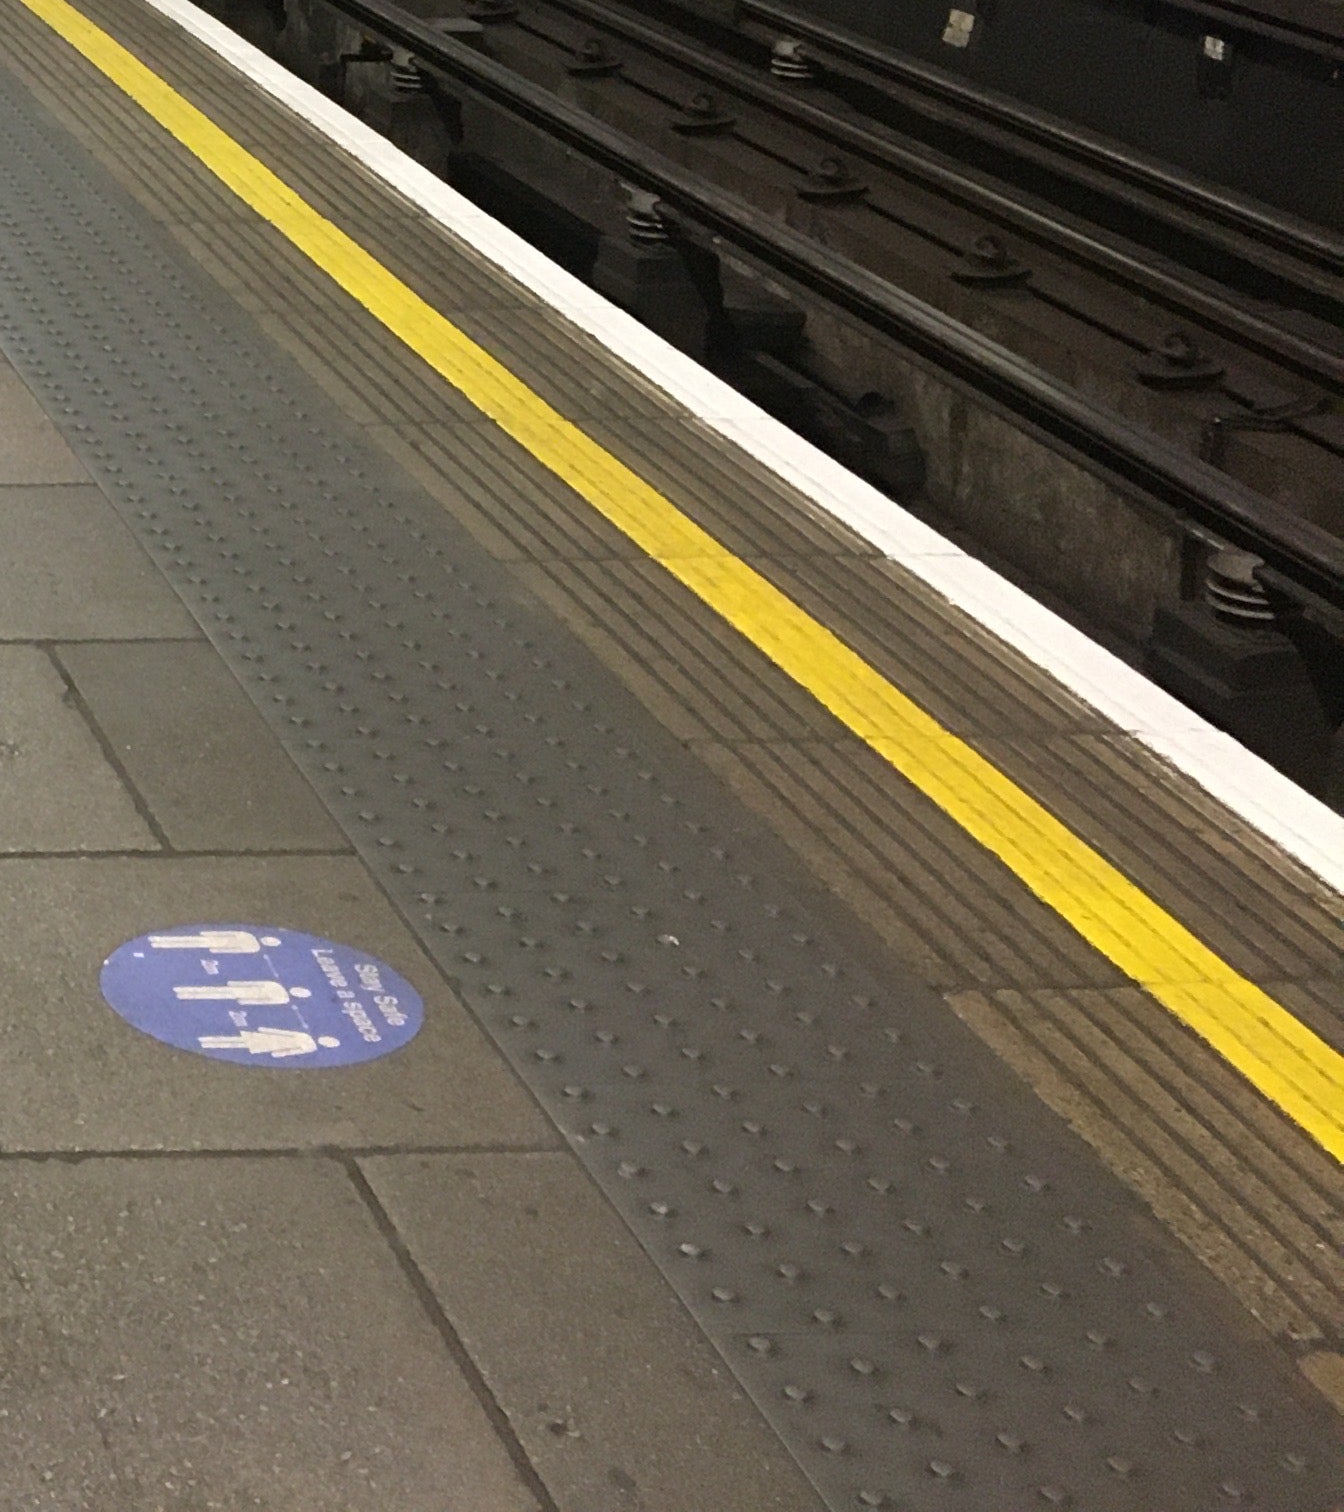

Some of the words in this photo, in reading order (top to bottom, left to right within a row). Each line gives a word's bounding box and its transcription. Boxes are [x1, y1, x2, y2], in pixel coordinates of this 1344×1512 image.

[311, 949, 348, 988] Leave
[341, 1001, 382, 1043] space
[354, 964, 385, 992] Stay
